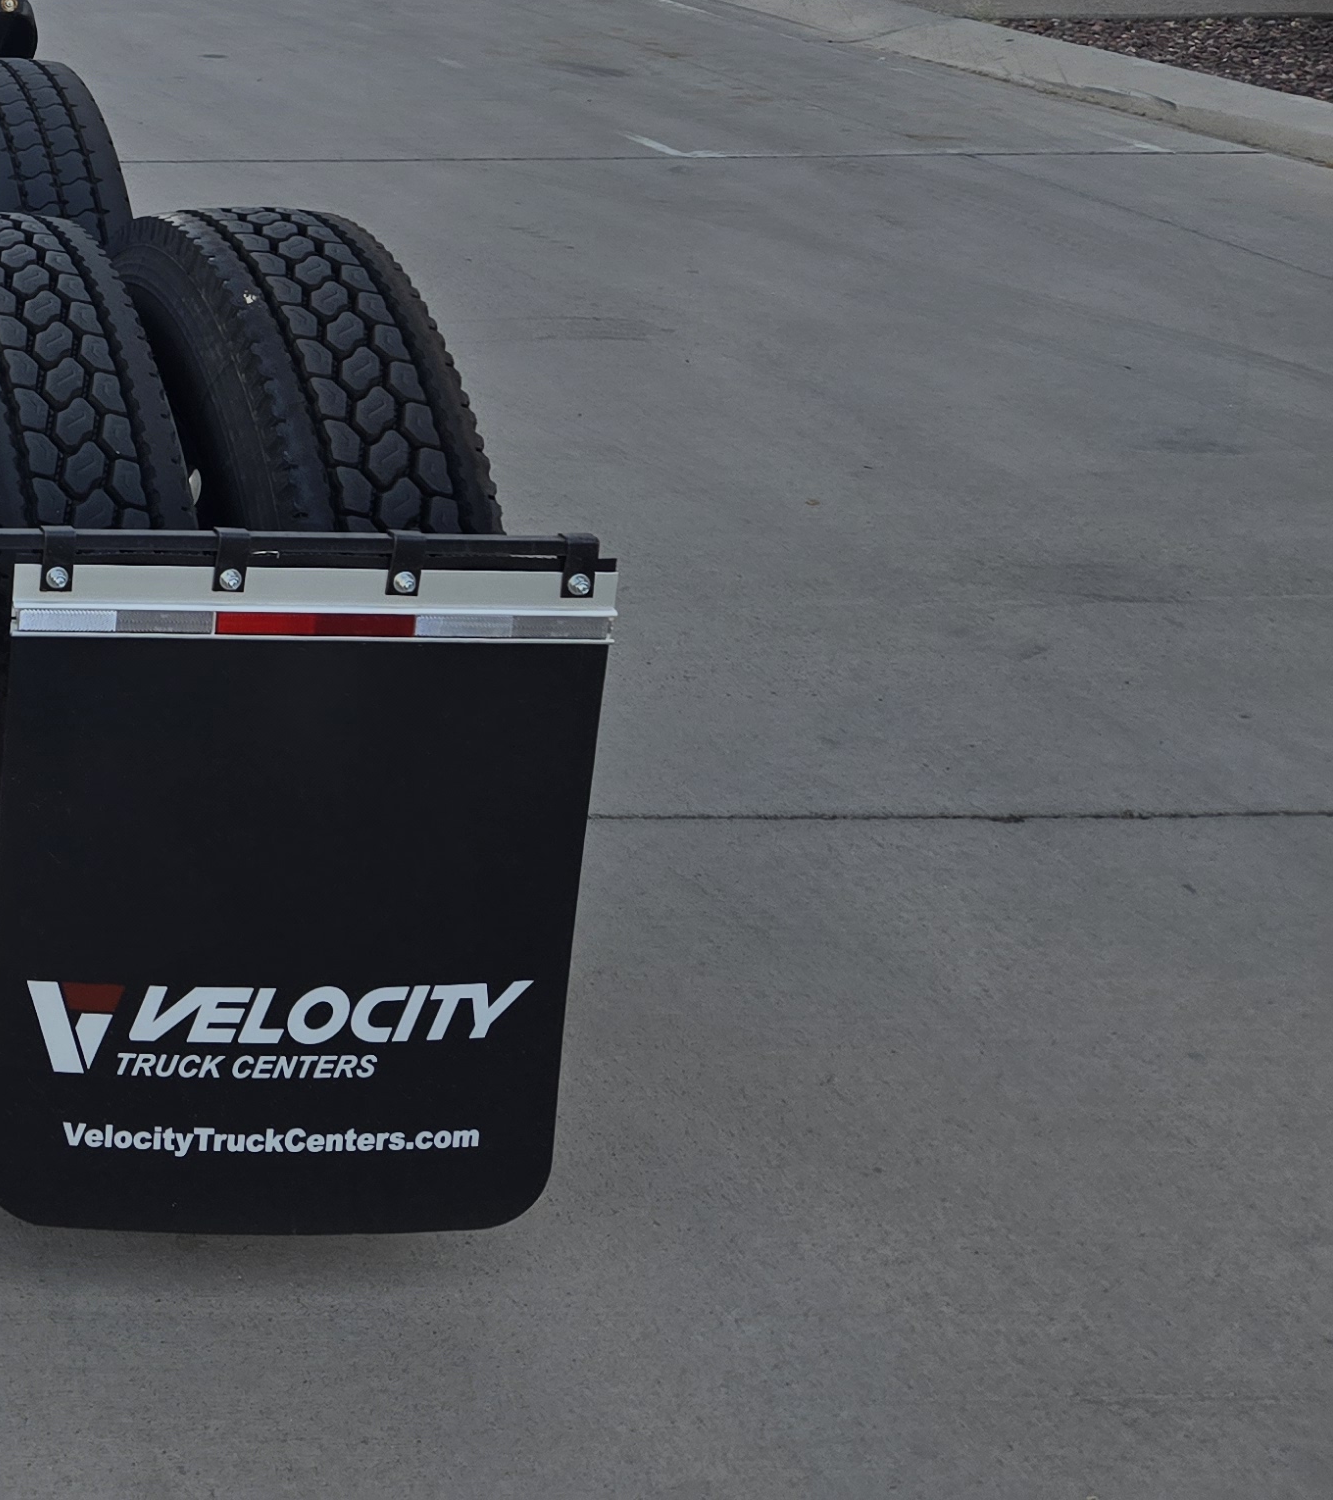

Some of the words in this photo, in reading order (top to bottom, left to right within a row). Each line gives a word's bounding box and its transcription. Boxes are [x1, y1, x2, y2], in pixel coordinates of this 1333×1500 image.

[128, 980, 535, 1045] VELOCITY
[115, 1052, 226, 1079] TRUCK
[231, 1054, 379, 1080] CENTERS
[62, 1120, 481, 1158] VelocityTruckCenters.com
